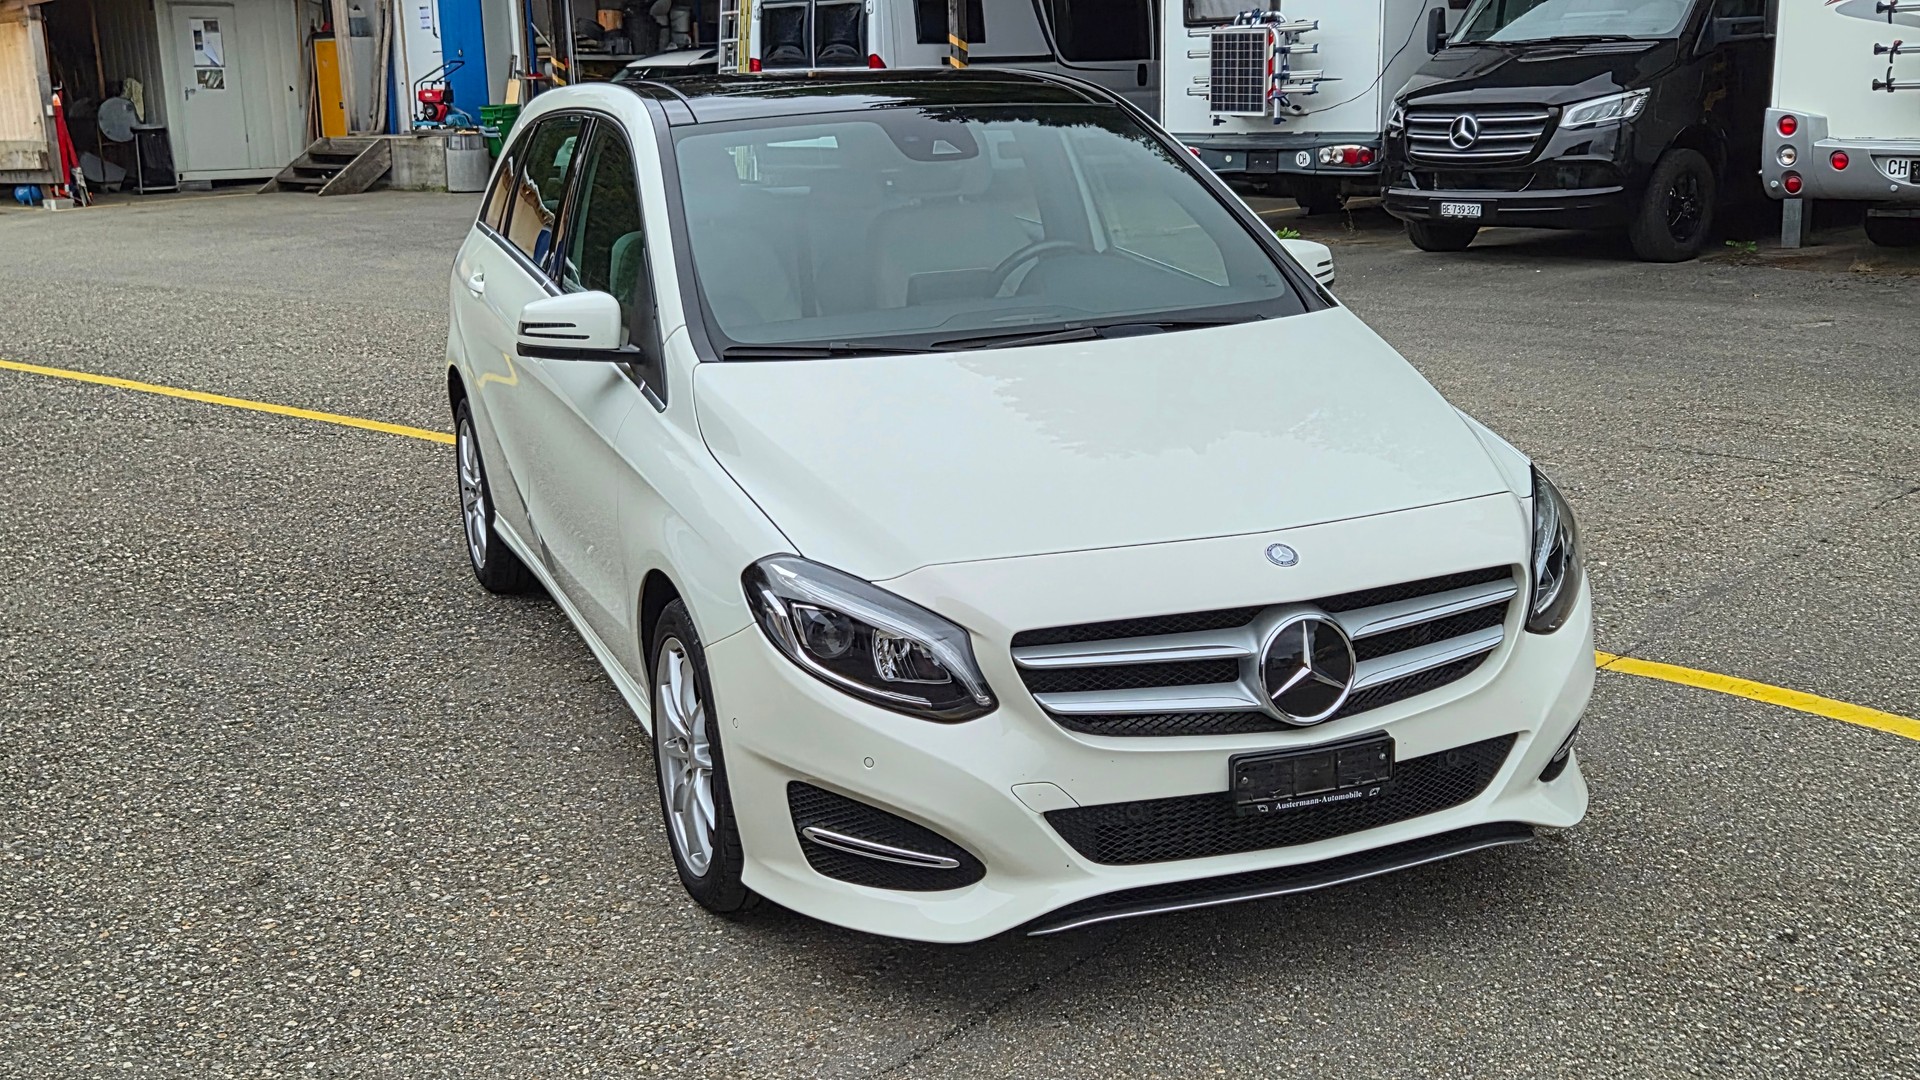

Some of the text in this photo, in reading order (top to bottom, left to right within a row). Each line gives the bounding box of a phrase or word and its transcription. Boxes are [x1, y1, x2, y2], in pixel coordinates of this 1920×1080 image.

[1298, 153, 1307, 165] CH
[1888, 159, 1908, 175] CH
[1275, 790, 1362, 810] Austermann-Automobile
